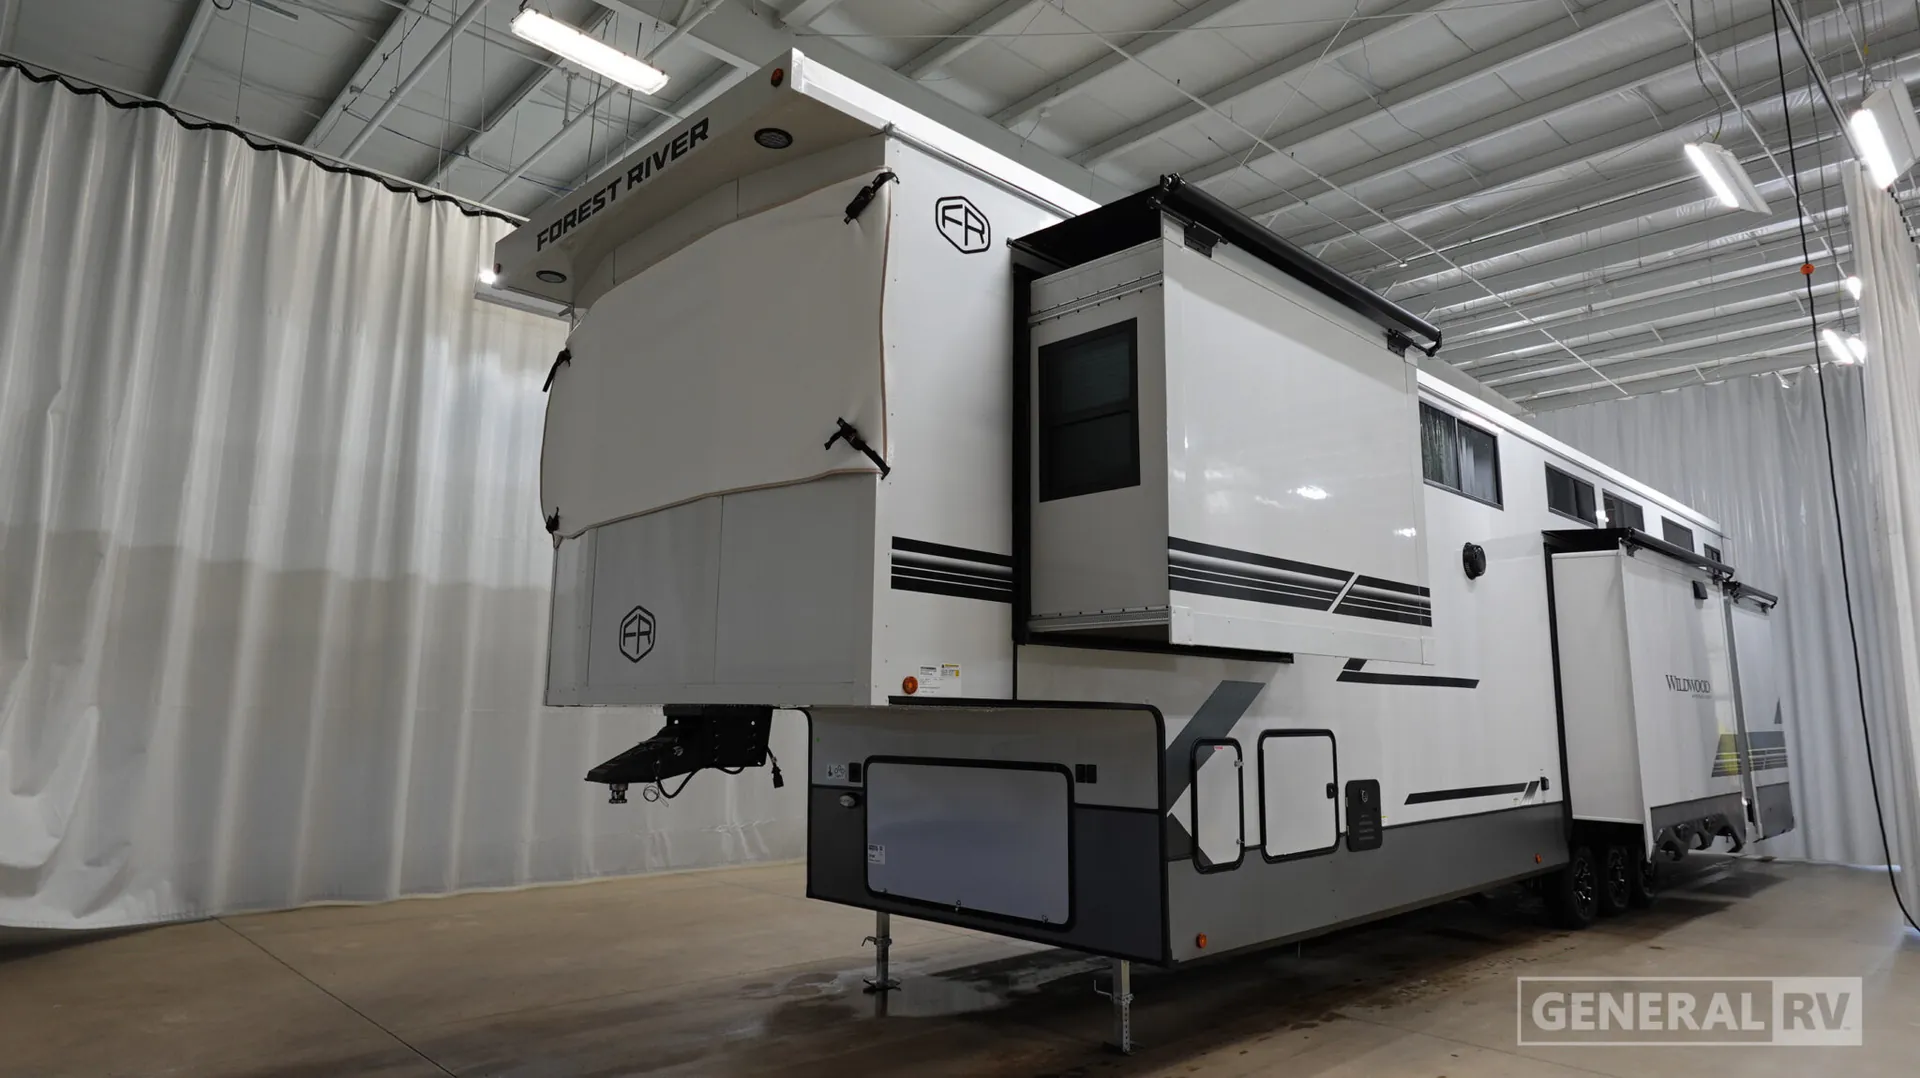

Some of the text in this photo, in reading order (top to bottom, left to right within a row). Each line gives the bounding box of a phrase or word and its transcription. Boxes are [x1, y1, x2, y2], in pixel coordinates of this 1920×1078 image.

[537, 117, 709, 252] FOREST RIVER
[942, 204, 985, 246] FR
